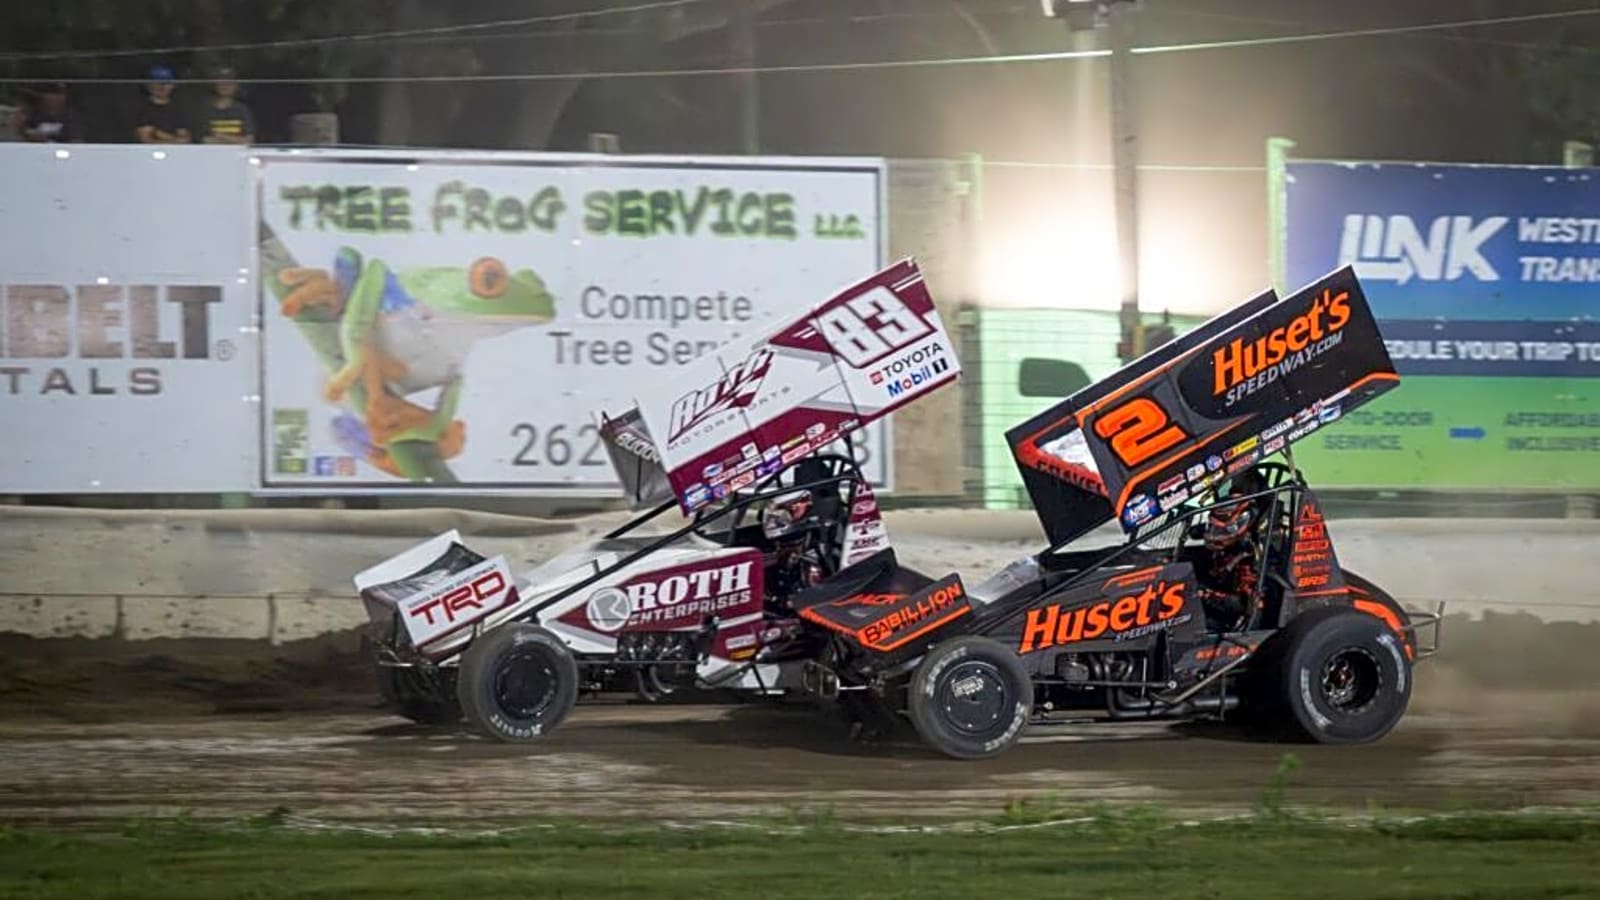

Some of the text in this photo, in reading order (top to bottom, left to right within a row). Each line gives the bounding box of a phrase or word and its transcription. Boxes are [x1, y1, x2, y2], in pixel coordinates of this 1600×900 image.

[279, 184, 412, 231] TREE
[433, 180, 566, 233] FROG
[585, 185, 797, 238] SERVICE
[1519, 217, 1600, 243] WEST
[1338, 214, 1508, 284] LINK
[0, 284, 222, 358] BELT
[581, 285, 753, 328] Compete
[810, 284, 935, 368] 83
[547, 331, 729, 365] Tree Ser
[882, 341, 944, 378] TOYOTA
[1213, 288, 1351, 396] Huset's
[1225, 330, 1343, 407] SPEEDWAY.COM
[887, 365, 932, 398] Mobil
[1094, 397, 1187, 468] 2
[410, 571, 506, 626] TRD
[626, 561, 753, 612] ROTH
[628, 590, 751, 627] ENTERPRISES
[1018, 581, 1187, 655] Huset's
